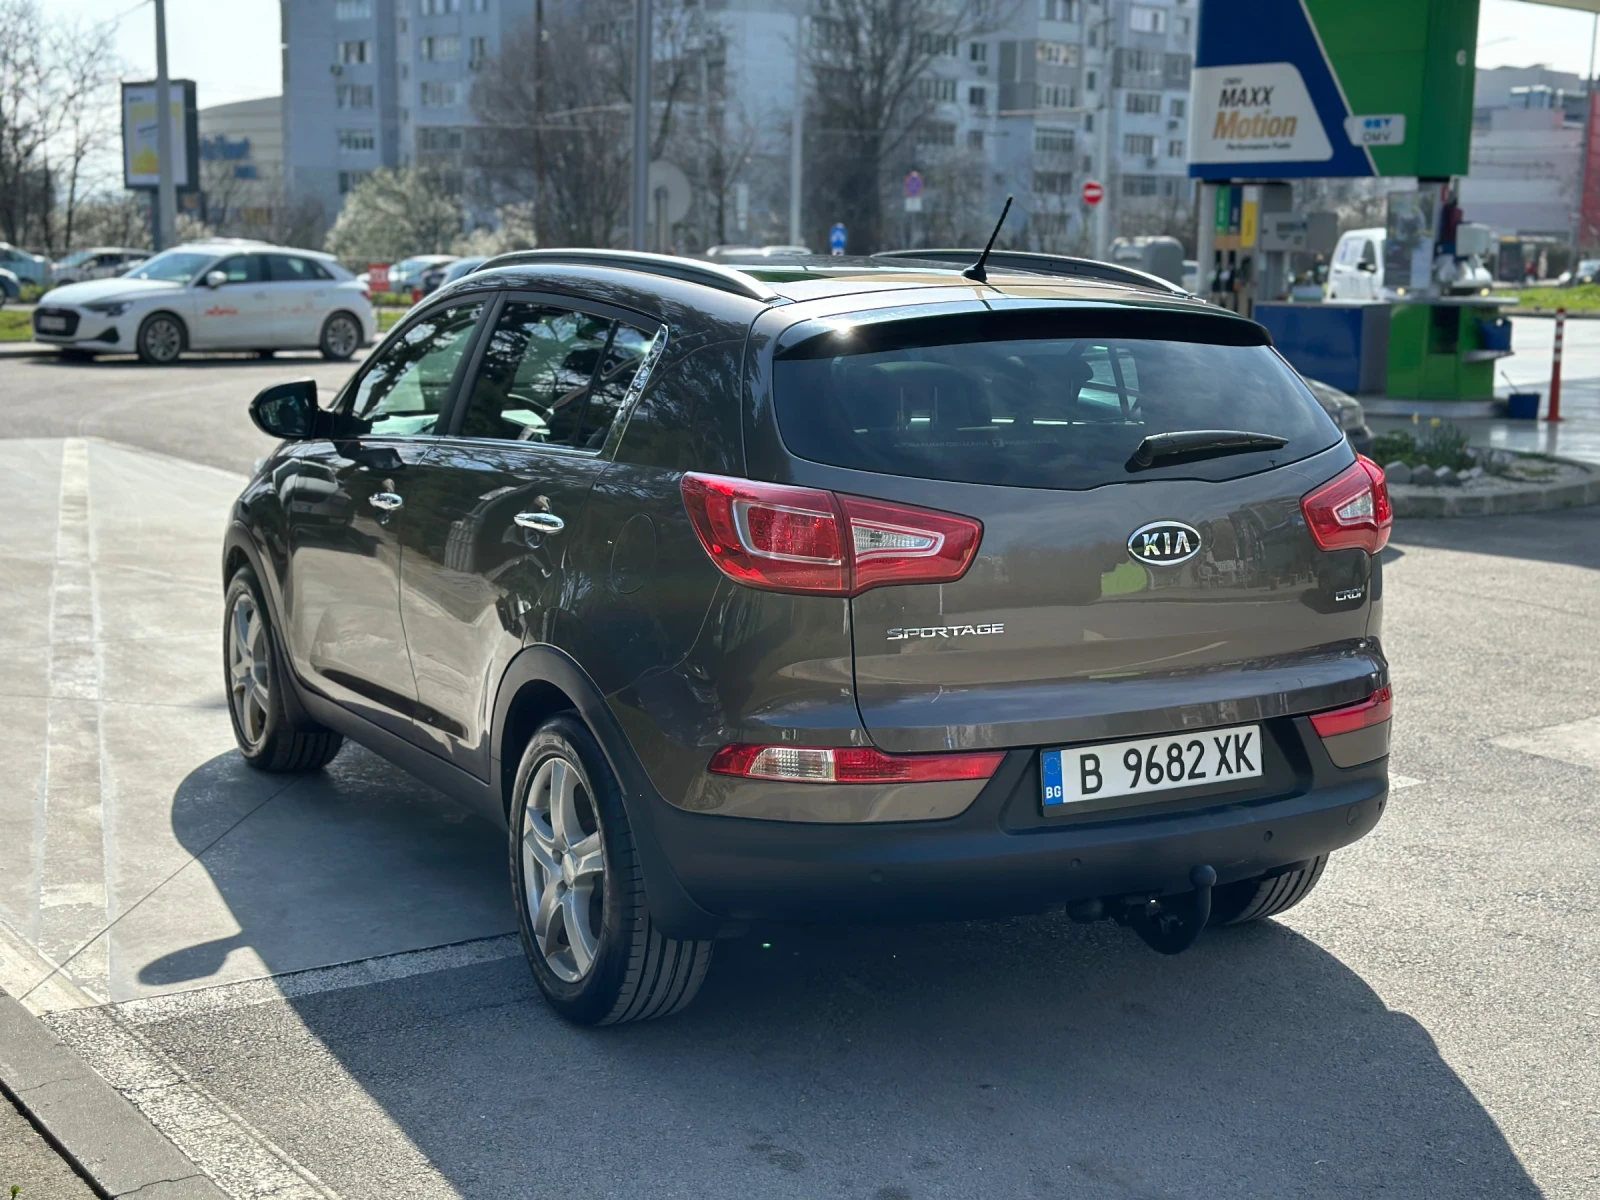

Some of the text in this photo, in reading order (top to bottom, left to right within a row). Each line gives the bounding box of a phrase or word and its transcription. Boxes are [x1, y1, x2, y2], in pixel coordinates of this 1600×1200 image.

[1219, 86, 1274, 108] MAXX
[1211, 109, 1298, 140] Motion
[1141, 531, 1191, 556] KIA
[886, 622, 1005, 641] SPORTAGE
[1079, 732, 1256, 796] B 9682 XK
[1045, 785, 1062, 800] BG
